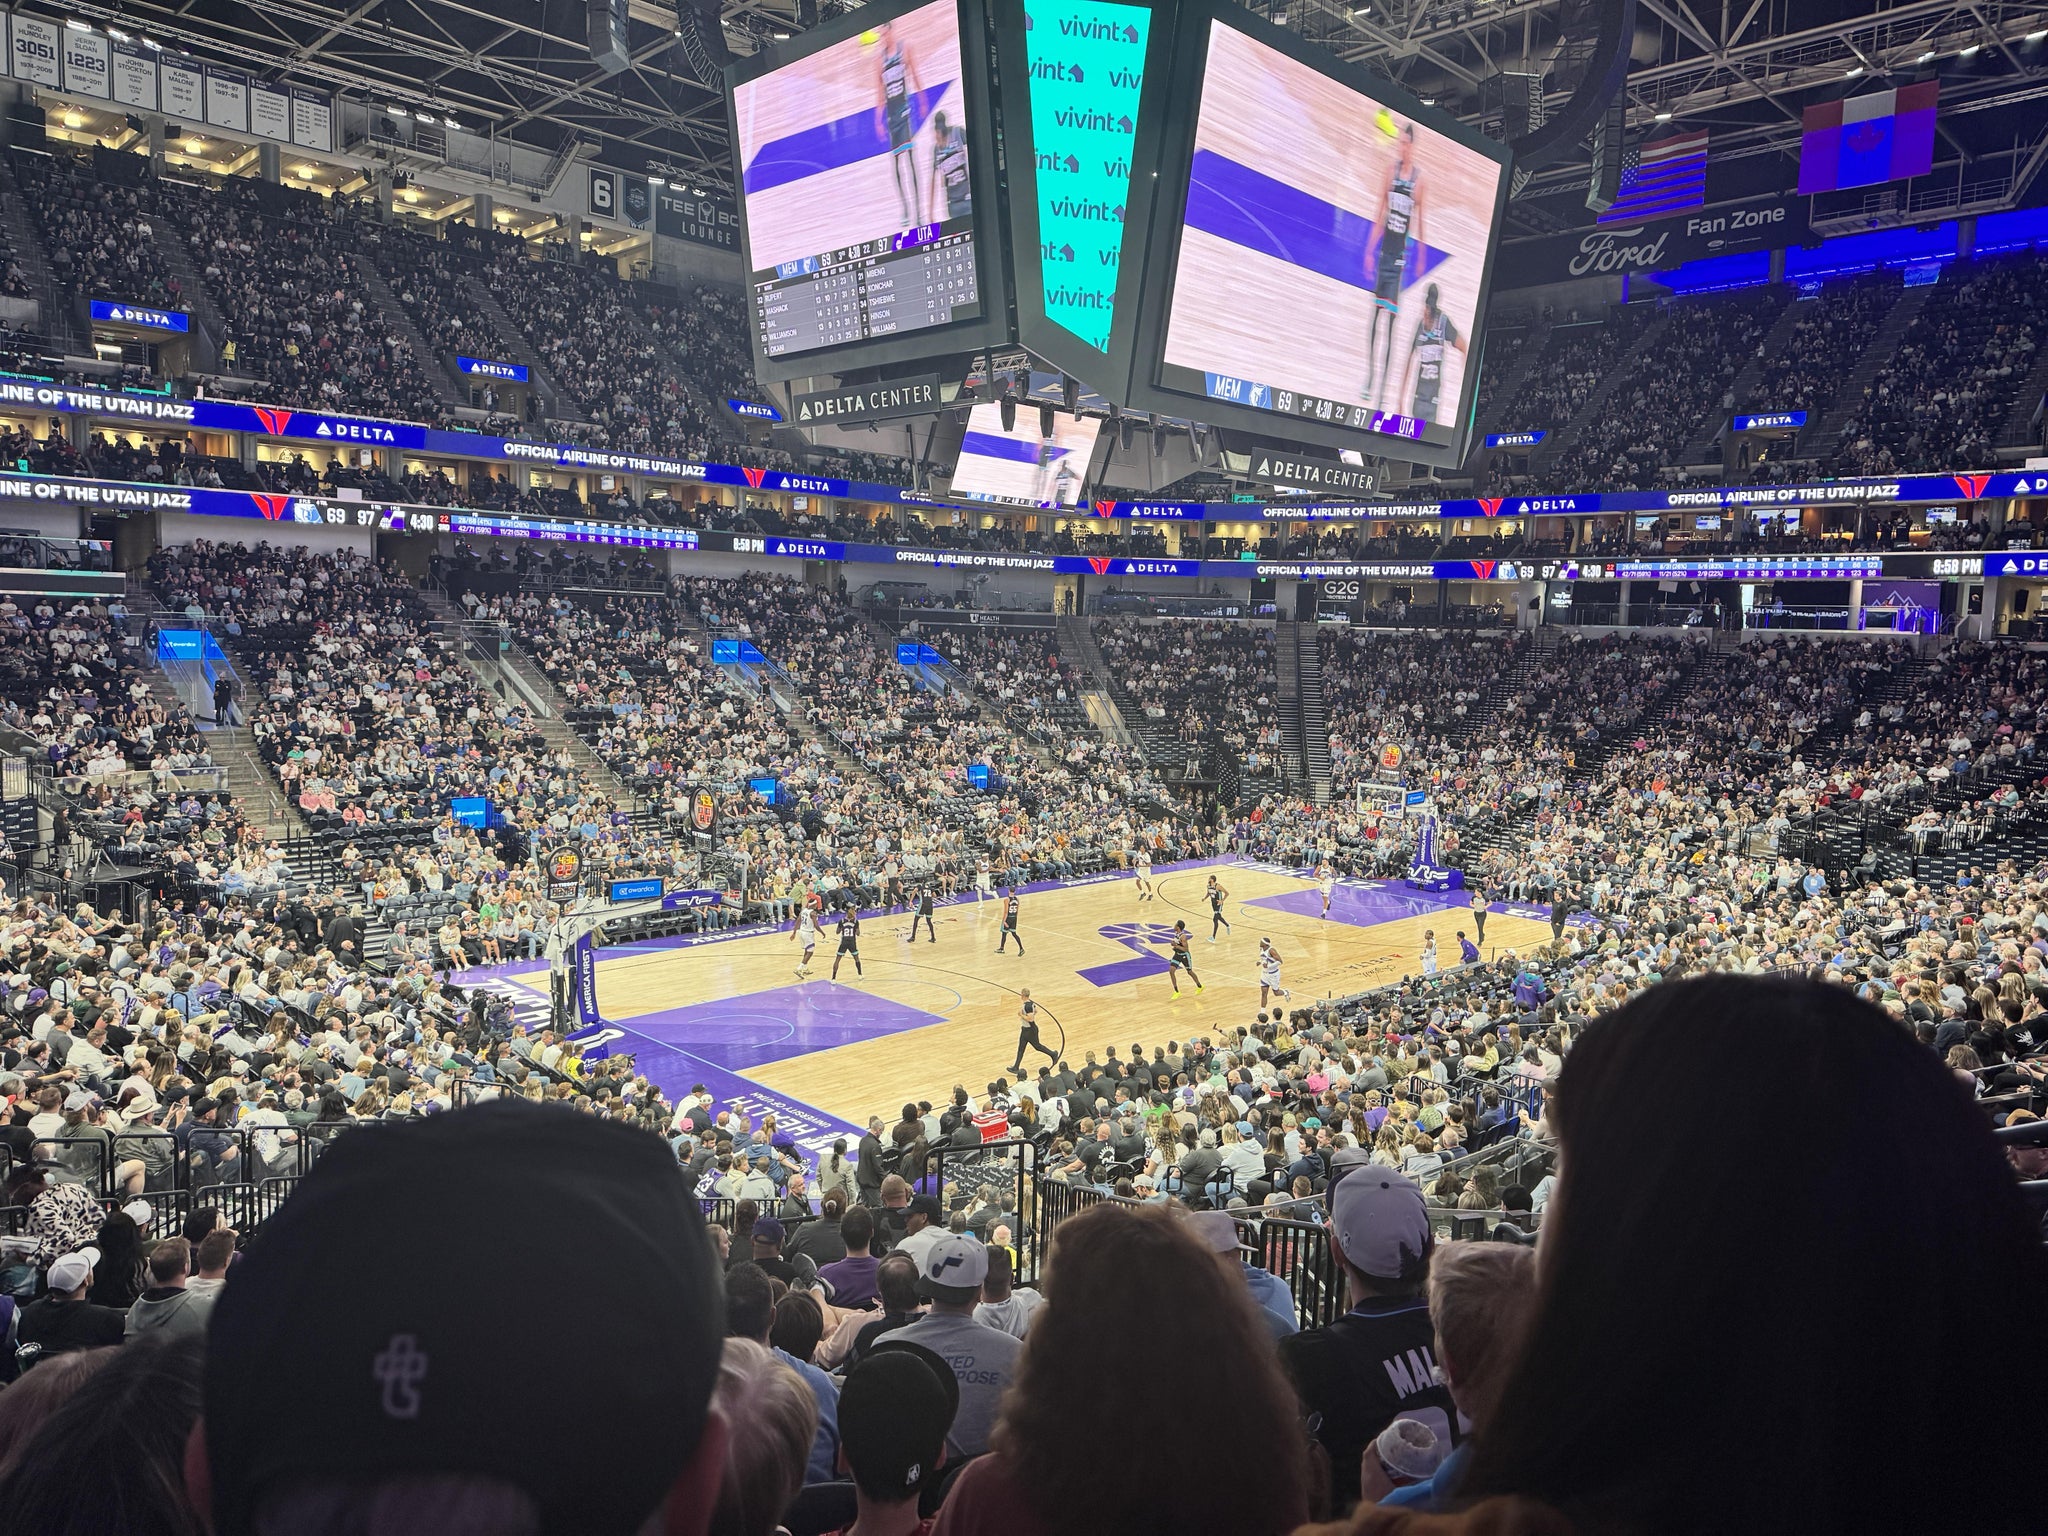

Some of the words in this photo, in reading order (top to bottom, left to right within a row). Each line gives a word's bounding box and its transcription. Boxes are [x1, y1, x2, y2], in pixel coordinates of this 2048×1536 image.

[18, 28, 52, 41] HUNDLEY
[26, 23, 43, 33] ROD
[74, 42, 98, 54] SLOAN
[75, 36, 97, 47] JERRY
[16, 38, 55, 60] 3051
[66, 51, 106, 72] 1223
[125, 58, 144, 68] JOHN
[117, 62, 153, 76] STOCKTON
[173, 71, 190, 80] KARL
[168, 76, 195, 87] MALONE
[214, 81, 239, 92] 1996-97
[215, 88, 239, 99] 1997-98
[593, 178, 611, 208] 6
[661, 196, 695, 216] TEE
[1687, 217, 1726, 236] Fan
[1731, 207, 1785, 229] Zone
[682, 221, 731, 245] LOUNGE
[917, 226, 933, 241] UTA
[878, 238, 888, 252] 97
[1569, 226, 1669, 276] Ford
[848, 245, 861, 261] 4:30
[863, 244, 871, 254] 22
[821, 253, 832, 267] 69
[782, 261, 798, 275] MEM
[866, 267, 886, 279] MBENG
[867, 280, 894, 292] KONCHAR
[125, 310, 170, 325] DELTA
[870, 309, 891, 320] HINSON
[769, 328, 797, 341] WILLIAMSON
[871, 322, 897, 334] WILLIAMS
[482, 364, 515, 377] DELTA
[1214, 375, 1242, 400] MEM
[37, 389, 64, 404] OF
[66, 392, 102, 409] THE
[104, 397, 153, 415] UTAH
[155, 402, 195, 419] JAZZ
[814, 395, 865, 418] DELTA
[870, 385, 932, 409] CENTER
[1277, 392, 1293, 412] 69
[746, 406, 772, 417] DELTA
[1315, 399, 1333, 420] 4:30
[1335, 405, 1345, 419] 22
[1353, 407, 1367, 427] 97
[1758, 415, 1792, 426] DELTA
[336, 423, 395, 442] DELTA
[1398, 416, 1416, 436] UTA
[1506, 434, 1534, 444] DELTA
[503, 442, 561, 460] OFFICIAL
[562, 450, 609, 466] AIRLINE
[610, 455, 626, 468] OF
[628, 457, 650, 471] THE
[651, 460, 681, 474] UTAH
[681, 464, 707, 477] JAZZ
[1274, 460, 1321, 482] DELTA
[1325, 469, 1374, 490] CENTER
[792, 478, 829, 492] DELTA
[34, 483, 61, 499] OF
[64, 485, 100, 502] THE
[102, 489, 149, 505] UTAH
[152, 493, 192, 508] JAZZ
[1668, 492, 1724, 505] OFFICIAL
[1726, 490, 1775, 503] AIRLINE
[1777, 489, 1796, 500] OF
[1799, 488, 1825, 499] THE
[1828, 486, 1862, 498] UTAH
[1867, 484, 1900, 498] JAZZ
[1144, 507, 1183, 516] DELTA
[1263, 507, 1309, 518] OFFICIAL
[1310, 507, 1351, 517] AIRLINE
[1351, 507, 1366, 516] OF
[1367, 506, 1387, 516] THE
[1389, 506, 1417, 515] UTAH
[1417, 505, 1441, 515] JAZZ
[1532, 499, 1576, 511] DELTA
[326, 507, 346, 524] 69
[357, 510, 375, 526] 97
[410, 513, 434, 531] 4:30
[439, 515, 449, 523] 22
[751, 538, 765, 553] PM
[789, 544, 826, 555] DELTA
[896, 551, 937, 563] OFFICIAL
[937, 554, 973, 565] AIRLINE
[974, 557, 987, 566] OF
[987, 557, 1006, 567] THE
[1007, 558, 1033, 568] UTAH
[1033, 559, 1055, 569] JAZZ
[1933, 559, 1959, 574] 8:58
[1962, 559, 1982, 574] PM
[1138, 563, 1178, 573] DELTA
[1257, 566, 1302, 575] OFFICIAL
[1304, 566, 1343, 575] AIRLINE
[1344, 566, 1360, 575] OF
[1360, 566, 1380, 575] THE
[1381, 565, 1409, 575] UTAH
[1410, 565, 1434, 576] JAZZ
[1520, 565, 1534, 578] 69
[1541, 565, 1555, 578] 97
[1582, 564, 1602, 578] 4:30
[1324, 580, 1359, 595] G2G
[558, 855, 576, 865] 4:30
[556, 864, 573, 877] 22
[628, 886, 655, 894] awardco
[923, 889, 931, 897] 72
[1008, 905, 1018, 913] 55
[844, 928, 853, 937] 21
[582, 949, 591, 976] FIRST
[585, 977, 594, 1015] AMERICA
[750, 1092, 774, 1106] UTAH
[722, 1096, 818, 1136] HEALTH
[785, 1105, 832, 1128] UNIVERSITY
[698, 1173, 714, 1192] 23
